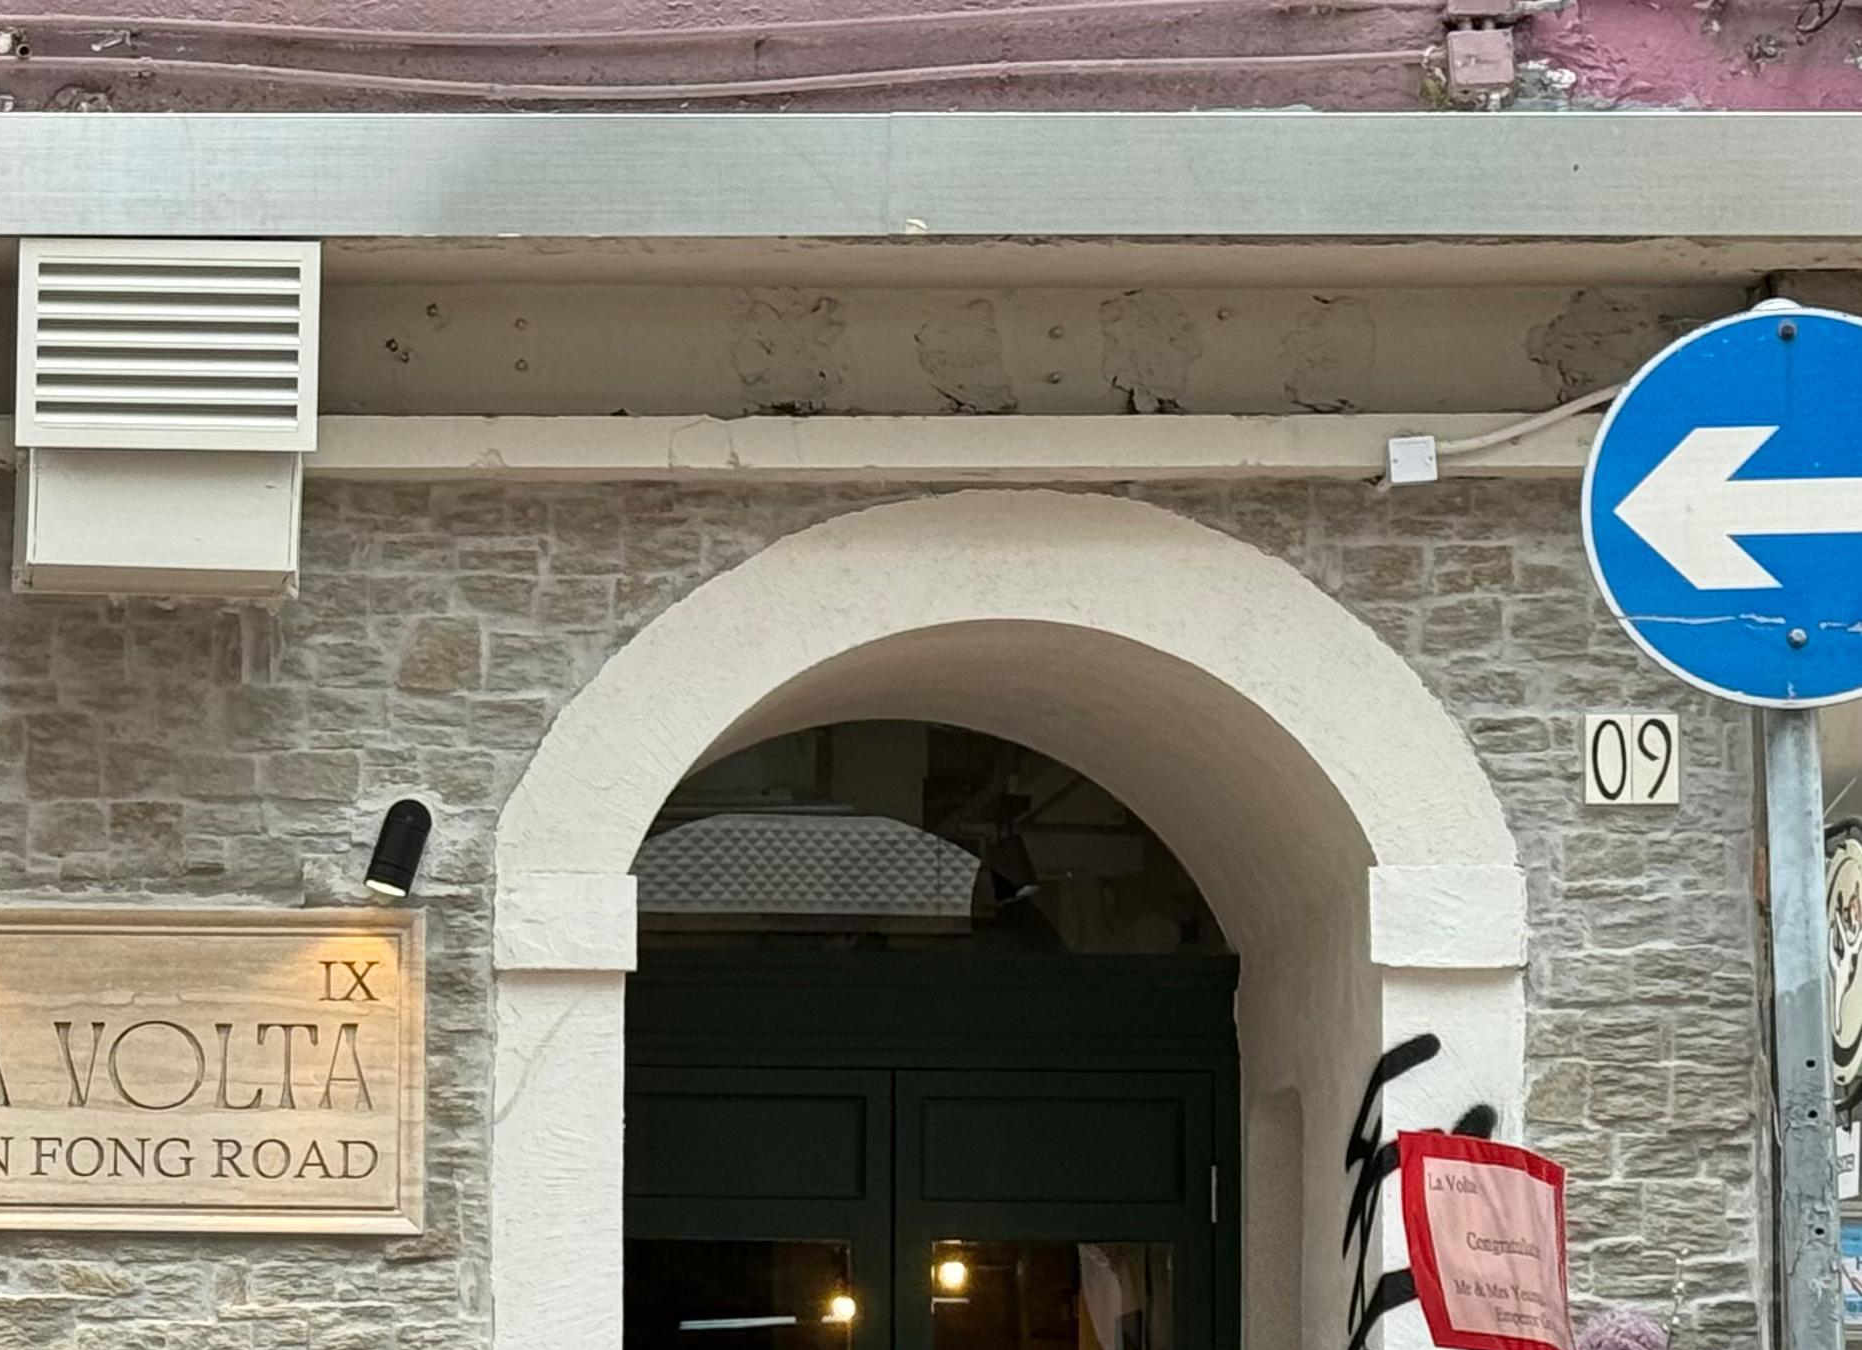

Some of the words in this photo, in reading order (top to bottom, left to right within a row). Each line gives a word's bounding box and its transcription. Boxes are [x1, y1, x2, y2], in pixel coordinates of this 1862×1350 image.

[1591, 718, 1673, 801] 09
[318, 960, 381, 1002] IX
[53, 1019, 375, 1112] VOLTA
[28, 1136, 196, 1180] FONG
[211, 1138, 380, 1181] ROAD
[1427, 1171, 1444, 1191] La
[1445, 1174, 1479, 1195] Volta
